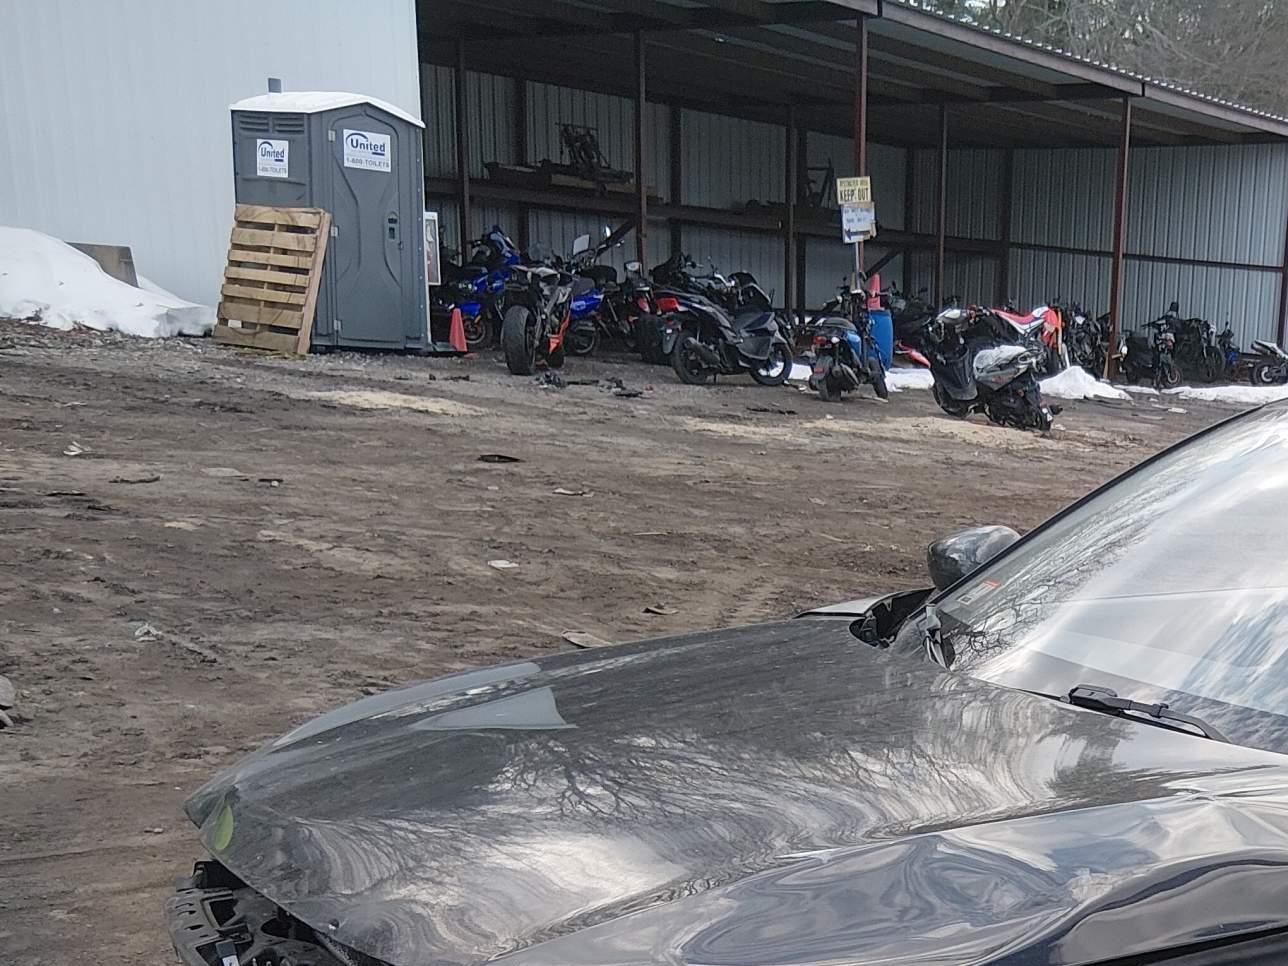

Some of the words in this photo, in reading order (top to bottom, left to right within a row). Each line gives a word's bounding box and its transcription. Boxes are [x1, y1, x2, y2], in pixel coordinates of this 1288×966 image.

[260, 146, 286, 159] United
[350, 137, 386, 153] United
[839, 188, 855, 202] KEEP
[857, 187, 869, 201] OUT
